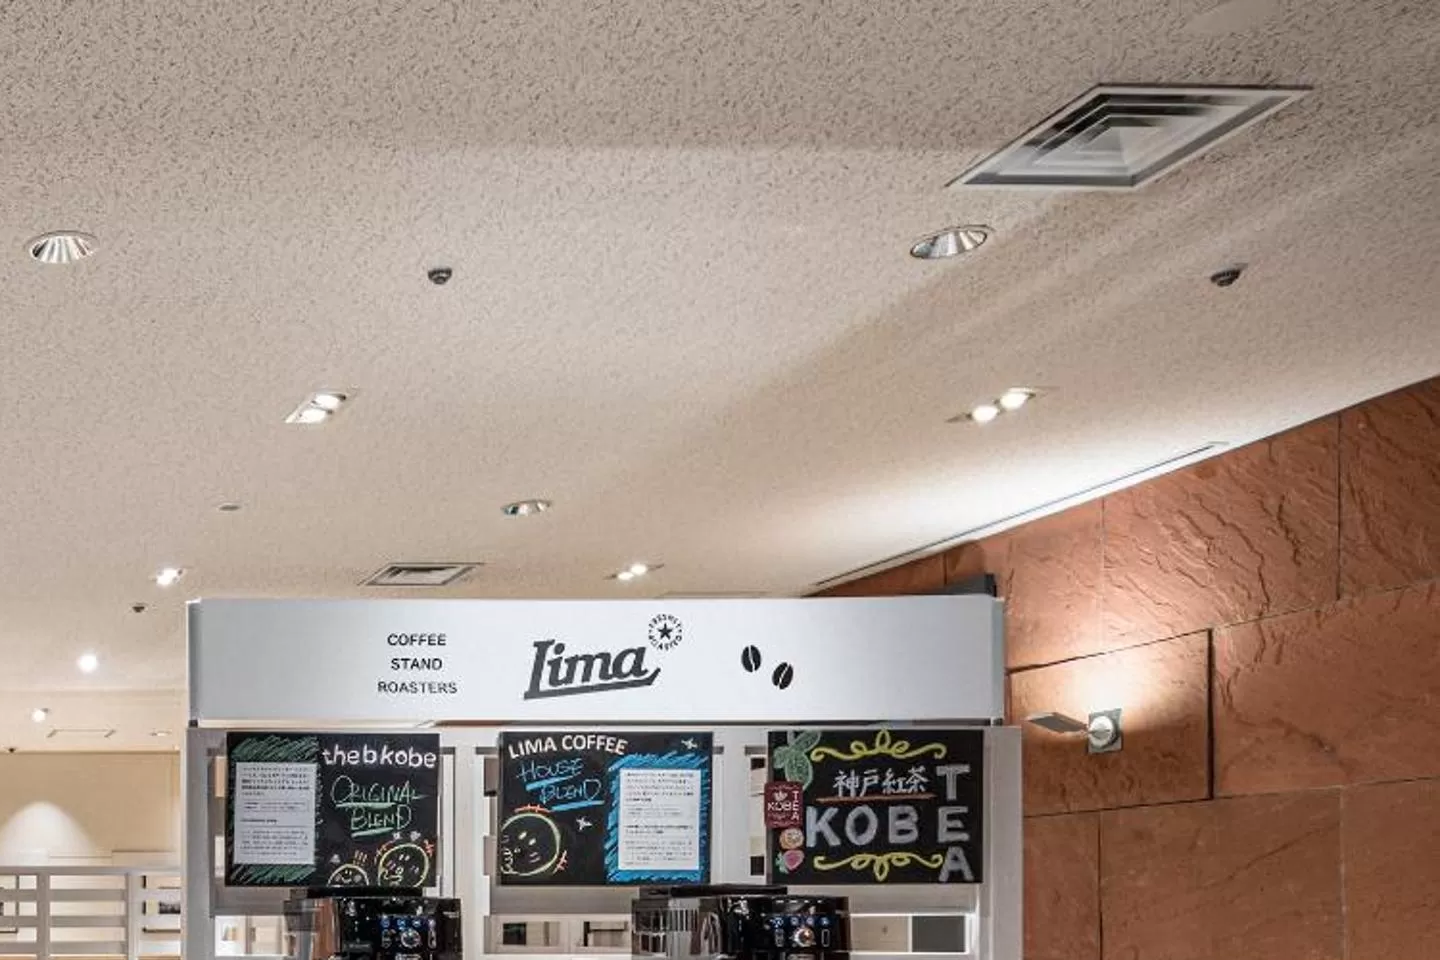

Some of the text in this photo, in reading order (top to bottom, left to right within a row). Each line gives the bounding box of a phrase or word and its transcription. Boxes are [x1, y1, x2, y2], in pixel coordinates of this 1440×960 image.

[387, 633, 447, 646] COFFEE
[391, 657, 443, 671] STAND
[523, 639, 661, 700] Lima
[377, 681, 458, 694] ROASTERS
[508, 734, 628, 759] LIMA COFFEE
[833, 765, 930, 798] 神戸紅茶
[936, 764, 974, 882] TEA
